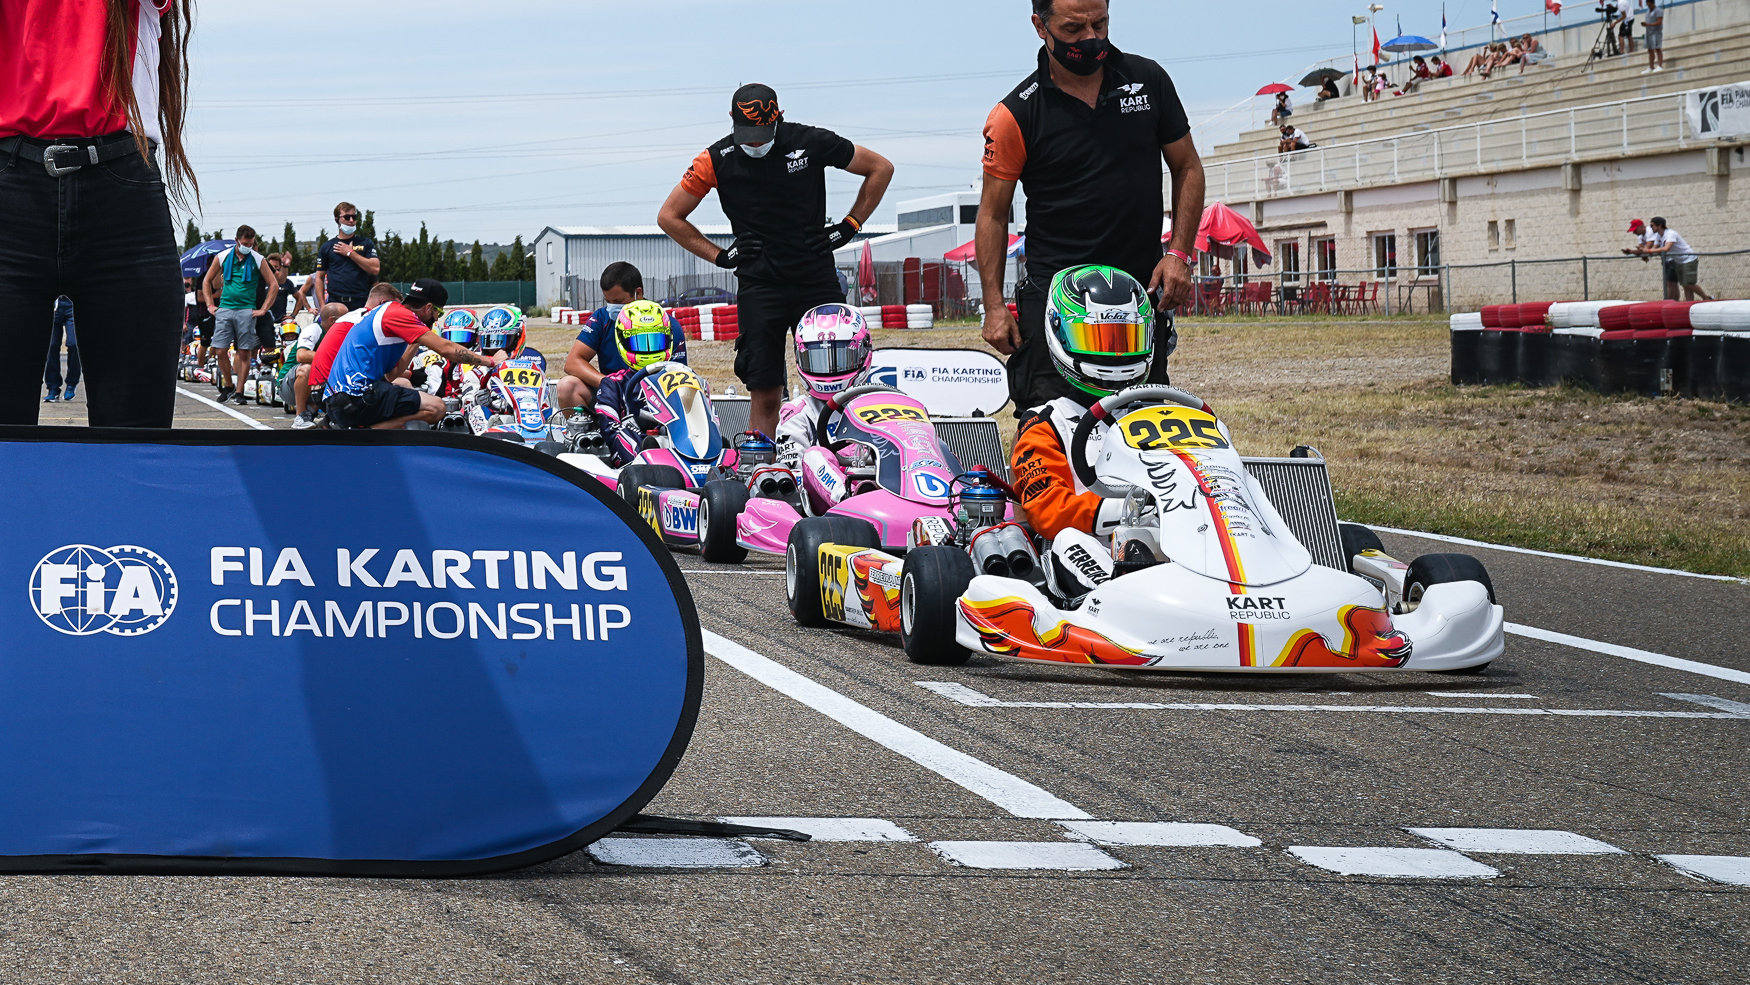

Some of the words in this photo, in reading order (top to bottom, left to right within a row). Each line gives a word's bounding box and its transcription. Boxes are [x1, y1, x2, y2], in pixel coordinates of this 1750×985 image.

[1119, 95, 1148, 108] KART
[1121, 104, 1150, 114] REPUBLIC
[786, 157, 809, 170] KART
[932, 367, 949, 375] FIA
[953, 367, 1001, 376] KARTING
[503, 370, 540, 387] 467
[663, 373, 696, 392] 22
[932, 376, 1002, 384] CHAMPIONSHIP
[823, 383, 843, 392] BWT
[1128, 418, 1230, 451] 225
[672, 506, 698, 531] BW
[210, 547, 315, 587] FIA
[337, 548, 628, 591] KARTING
[1064, 544, 1109, 586] FERREIRA
[1088, 606, 1099, 614] KART
[1226, 597, 1285, 610] KART
[210, 599, 631, 641] CHAMPIONSHIP
[1231, 611, 1290, 619] REPUBLIC
